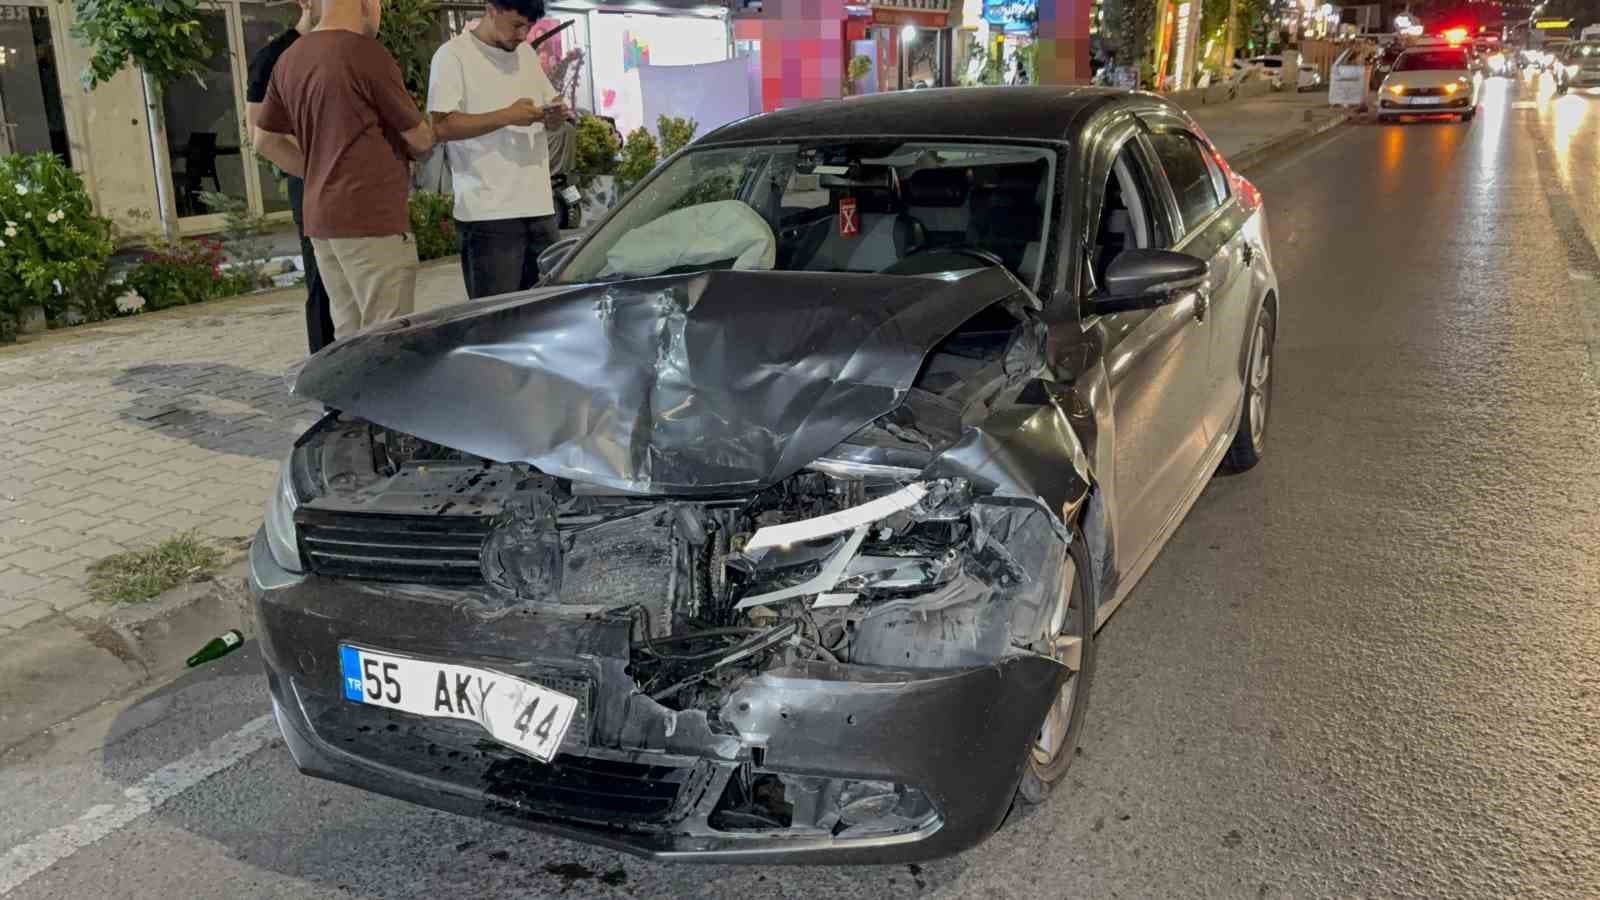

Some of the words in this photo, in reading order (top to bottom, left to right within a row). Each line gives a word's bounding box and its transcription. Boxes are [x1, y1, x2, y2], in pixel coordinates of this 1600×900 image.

[346, 677, 362, 692] TR
[363, 658, 402, 704] 55
[434, 669, 497, 721] AKY
[513, 696, 560, 748] 44
